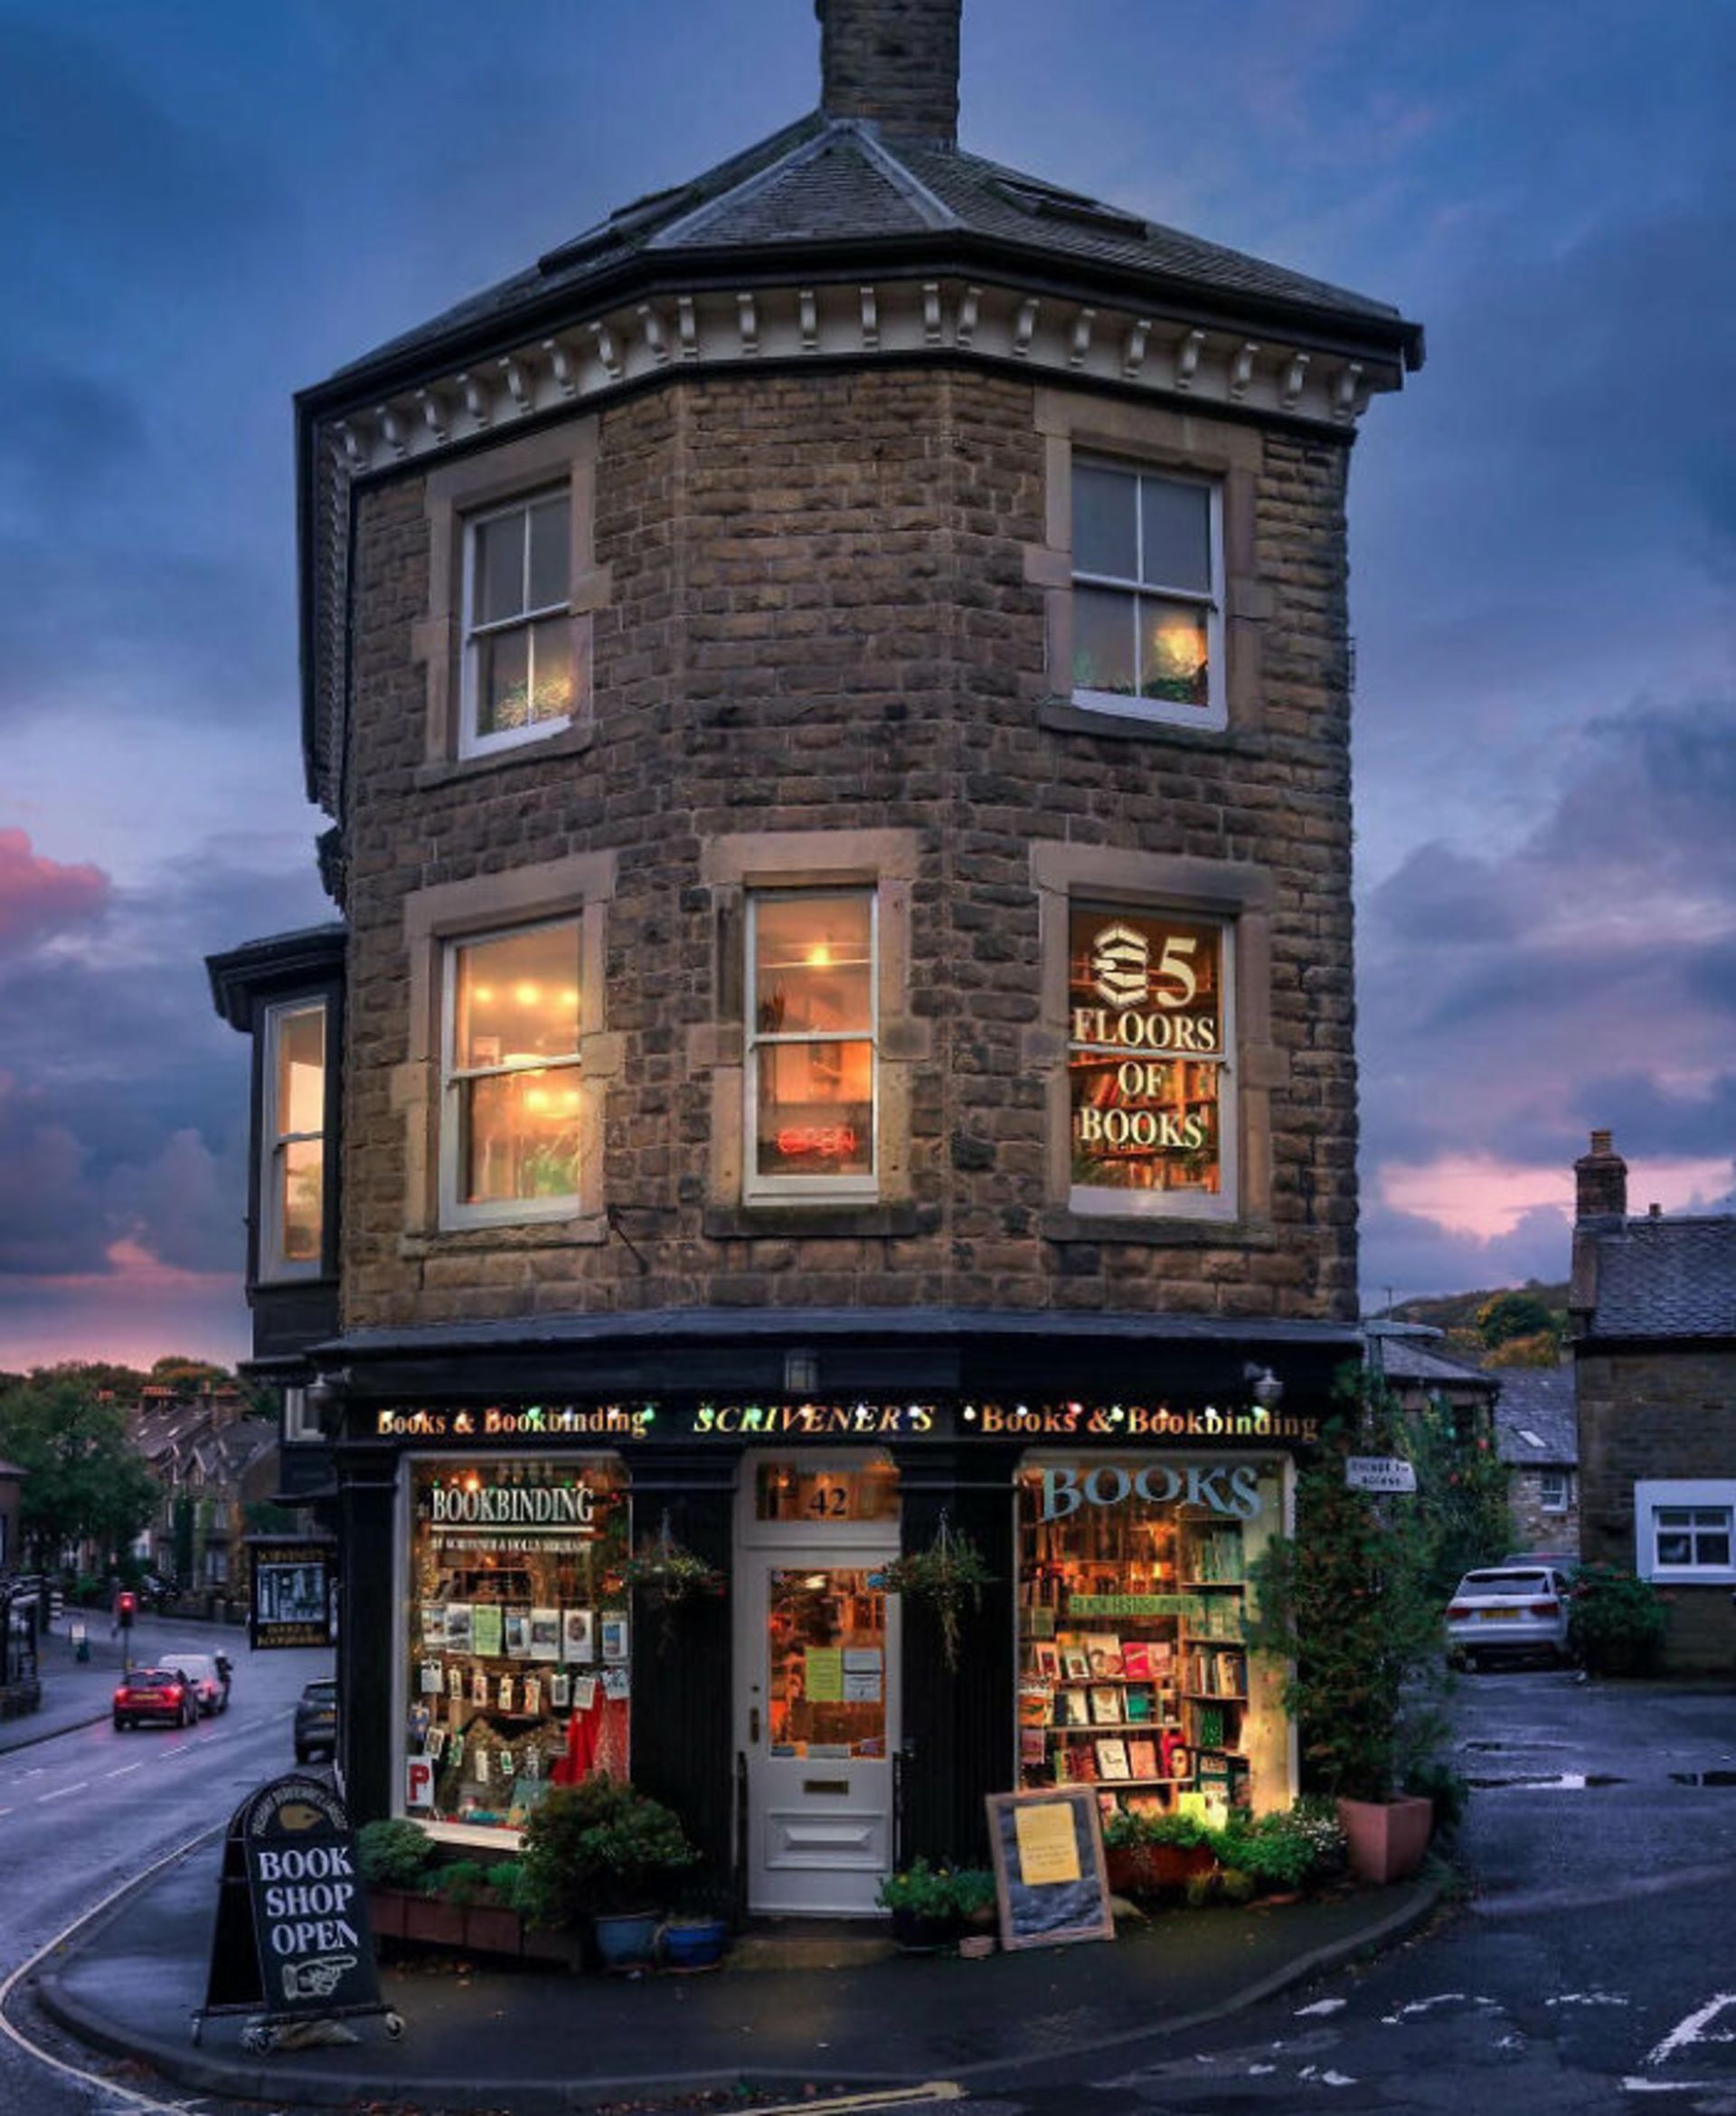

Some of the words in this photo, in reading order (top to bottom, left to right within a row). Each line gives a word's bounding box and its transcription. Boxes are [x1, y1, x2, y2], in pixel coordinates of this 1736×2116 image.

[1157, 937, 1197, 1007] 5
[1072, 1007, 1215, 1051] FLOORS
[1118, 1061, 1166, 1098] OF
[1080, 1107, 1203, 1149] BOOKS
[377, 1410, 446, 1435] Books
[453, 1412, 476, 1434] &
[485, 1407, 647, 1439] Bookbinding
[980, 1404, 1078, 1434] Books
[1087, 1411, 1115, 1433] &
[1127, 1406, 1319, 1443] Bookbinding
[431, 1488, 594, 1522] BOOKBINDING
[809, 1488, 848, 1516] 42
[1040, 1465, 1263, 1523] BOOKS
[258, 1847, 354, 1882] BOOK
[267, 1884, 354, 1917] SHOP
[272, 1920, 358, 1955] OPEN
